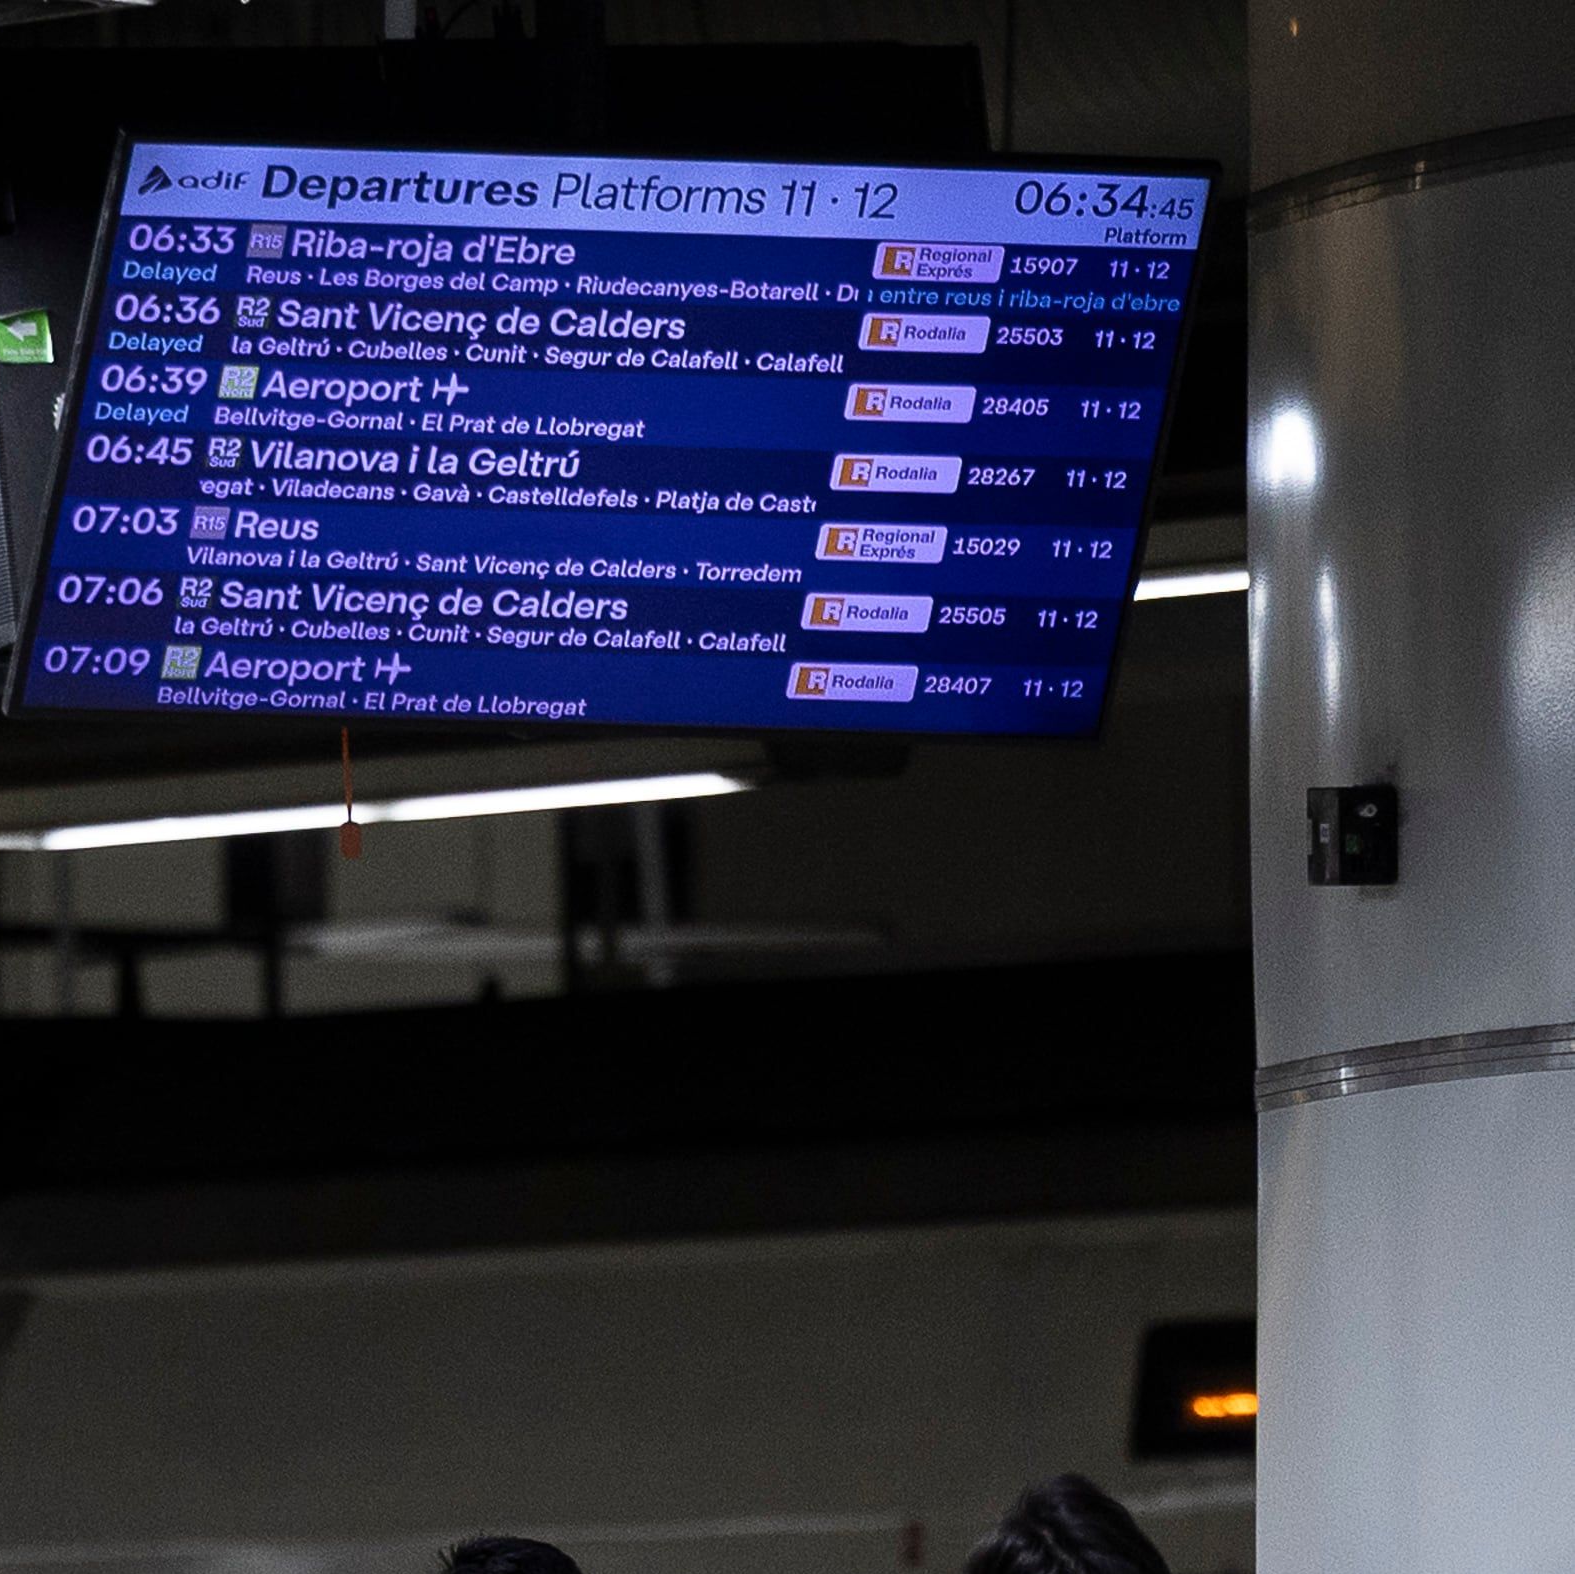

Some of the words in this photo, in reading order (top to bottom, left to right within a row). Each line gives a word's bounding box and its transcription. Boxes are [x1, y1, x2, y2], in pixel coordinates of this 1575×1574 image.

[176, 169, 250, 190] adif
[260, 163, 539, 210] Departures
[551, 171, 766, 215] Platforms
[780, 178, 817, 217] 11
[853, 181, 898, 219] 12
[128, 222, 236, 254] 06:33
[251, 231, 285, 251] R15
[290, 228, 453, 268] Riba-roja
[461, 233, 576, 265] d'Ebre
[1103, 226, 1188, 246] Platform
[918, 246, 993, 264] Regional
[1009, 255, 1079, 275] 15907
[121, 259, 218, 285] Delayed
[915, 261, 973, 280] Exprés
[1109, 259, 1129, 278] 11
[1146, 260, 1171, 280] 12
[245, 264, 302, 285] Reus
[318, 266, 359, 287] Les
[363, 267, 445, 293] Borges
[448, 270, 486, 291] del
[490, 272, 559, 297] Camp
[575, 274, 819, 302] Riudecanyes-Botarell
[114, 292, 221, 325] 06:36
[234, 295, 273, 319] R2
[878, 286, 939, 305] entre
[943, 290, 992, 307] reus
[996, 287, 1005, 307] i
[1008, 288, 1106, 314] riba-roja
[1110, 291, 1181, 312] d'ebre
[235, 315, 266, 329] Sud
[276, 298, 359, 330] Sant
[368, 301, 487, 340] Vicenç
[494, 305, 541, 335] de
[549, 307, 686, 340] Calders
[107, 330, 204, 356] Delayed
[902, 324, 966, 341] Rodalia
[995, 325, 1064, 346] 25503
[1094, 329, 1115, 348] 11
[1132, 330, 1156, 350] 12
[230, 334, 253, 354] la
[257, 335, 331, 357] Geltrú
[347, 339, 448, 361] Cubelles
[464, 342, 528, 364] Cunit
[543, 344, 613, 370] Segur
[615, 346, 646, 367] de
[649, 348, 739, 370] Calafell
[755, 351, 844, 373] Calafell
[100, 363, 208, 395] 06:39
[220, 365, 258, 389] R2
[260, 369, 424, 407] Aeroport
[93, 400, 190, 426] Delayed
[888, 394, 952, 411] Rodalia
[981, 396, 1050, 416] 28405
[1080, 399, 1100, 418] 11
[1118, 400, 1142, 420] 12
[213, 405, 404, 431] Bellvitge-Gornal
[420, 412, 444, 432] El
[448, 413, 496, 434] Prat
[499, 414, 531, 435] de
[534, 415, 645, 442] Llobregat
[86, 433, 194, 465] 06:45
[205, 435, 244, 459] R2
[250, 439, 399, 473] Vilanova
[407, 444, 420, 473] i
[426, 444, 459, 475] la
[467, 447, 580, 478] Geltrú
[206, 454, 237, 469] Sud
[874, 465, 938, 481] Rodalia
[966, 466, 1036, 486] 28267
[1065, 468, 1086, 488] 11
[1103, 470, 1127, 489] 12
[199, 476, 254, 499] egat
[271, 477, 395, 501] Viladecans
[411, 482, 471, 503] Gavà
[487, 484, 639, 508] Castelldefels
[654, 489, 720, 514] Platja
[723, 490, 754, 511] de
[72, 504, 180, 536] 07:03
[192, 512, 229, 533] R15
[233, 509, 319, 541] Reus
[861, 527, 936, 545] Regional
[951, 536, 1021, 556] 15029
[858, 542, 916, 561] Exprés
[1051, 538, 1072, 558] 11
[1089, 539, 1113, 559] 12
[186, 545, 283, 567] Vilanova
[287, 548, 296, 568] i
[299, 548, 321, 568] la
[325, 550, 399, 571] Geltrú
[415, 552, 468, 573] Sant
[473, 554, 550, 580] Vicenç
[553, 556, 585, 577] de
[588, 557, 677, 579] Calders
[695, 561, 802, 583] Torredem
[57, 574, 164, 606] 07:06
[177, 575, 215, 599] R2
[178, 594, 209, 609] Sud
[219, 580, 302, 610] Sant
[311, 582, 430, 621] Vicenç
[437, 586, 483, 616] de
[491, 588, 629, 620] Calders
[845, 604, 909, 620] Rodalia
[937, 605, 1006, 625] 25505
[1037, 608, 1057, 628] 11
[1074, 609, 1099, 629] 12
[173, 614, 195, 634] la
[200, 616, 274, 637] Geltrú
[290, 619, 390, 641] Cubelles
[407, 622, 470, 643] Cunit
[485, 624, 555, 649] Segur
[557, 626, 588, 647] de
[592, 628, 681, 650] Calafell
[697, 631, 787, 653] Calafell
[43, 644, 151, 676] 07:09
[163, 645, 201, 669] R2
[203, 649, 366, 687] Aeroport
[830, 673, 894, 690] Rodalia
[923, 674, 992, 695] 28407
[1022, 678, 1043, 697] 11
[1060, 679, 1084, 698] 12
[156, 685, 346, 710] Bellvitge-Gornal
[363, 690, 386, 710] El
[390, 691, 438, 712] Prat
[441, 692, 472, 713] de
[476, 694, 588, 719] Llobregat
